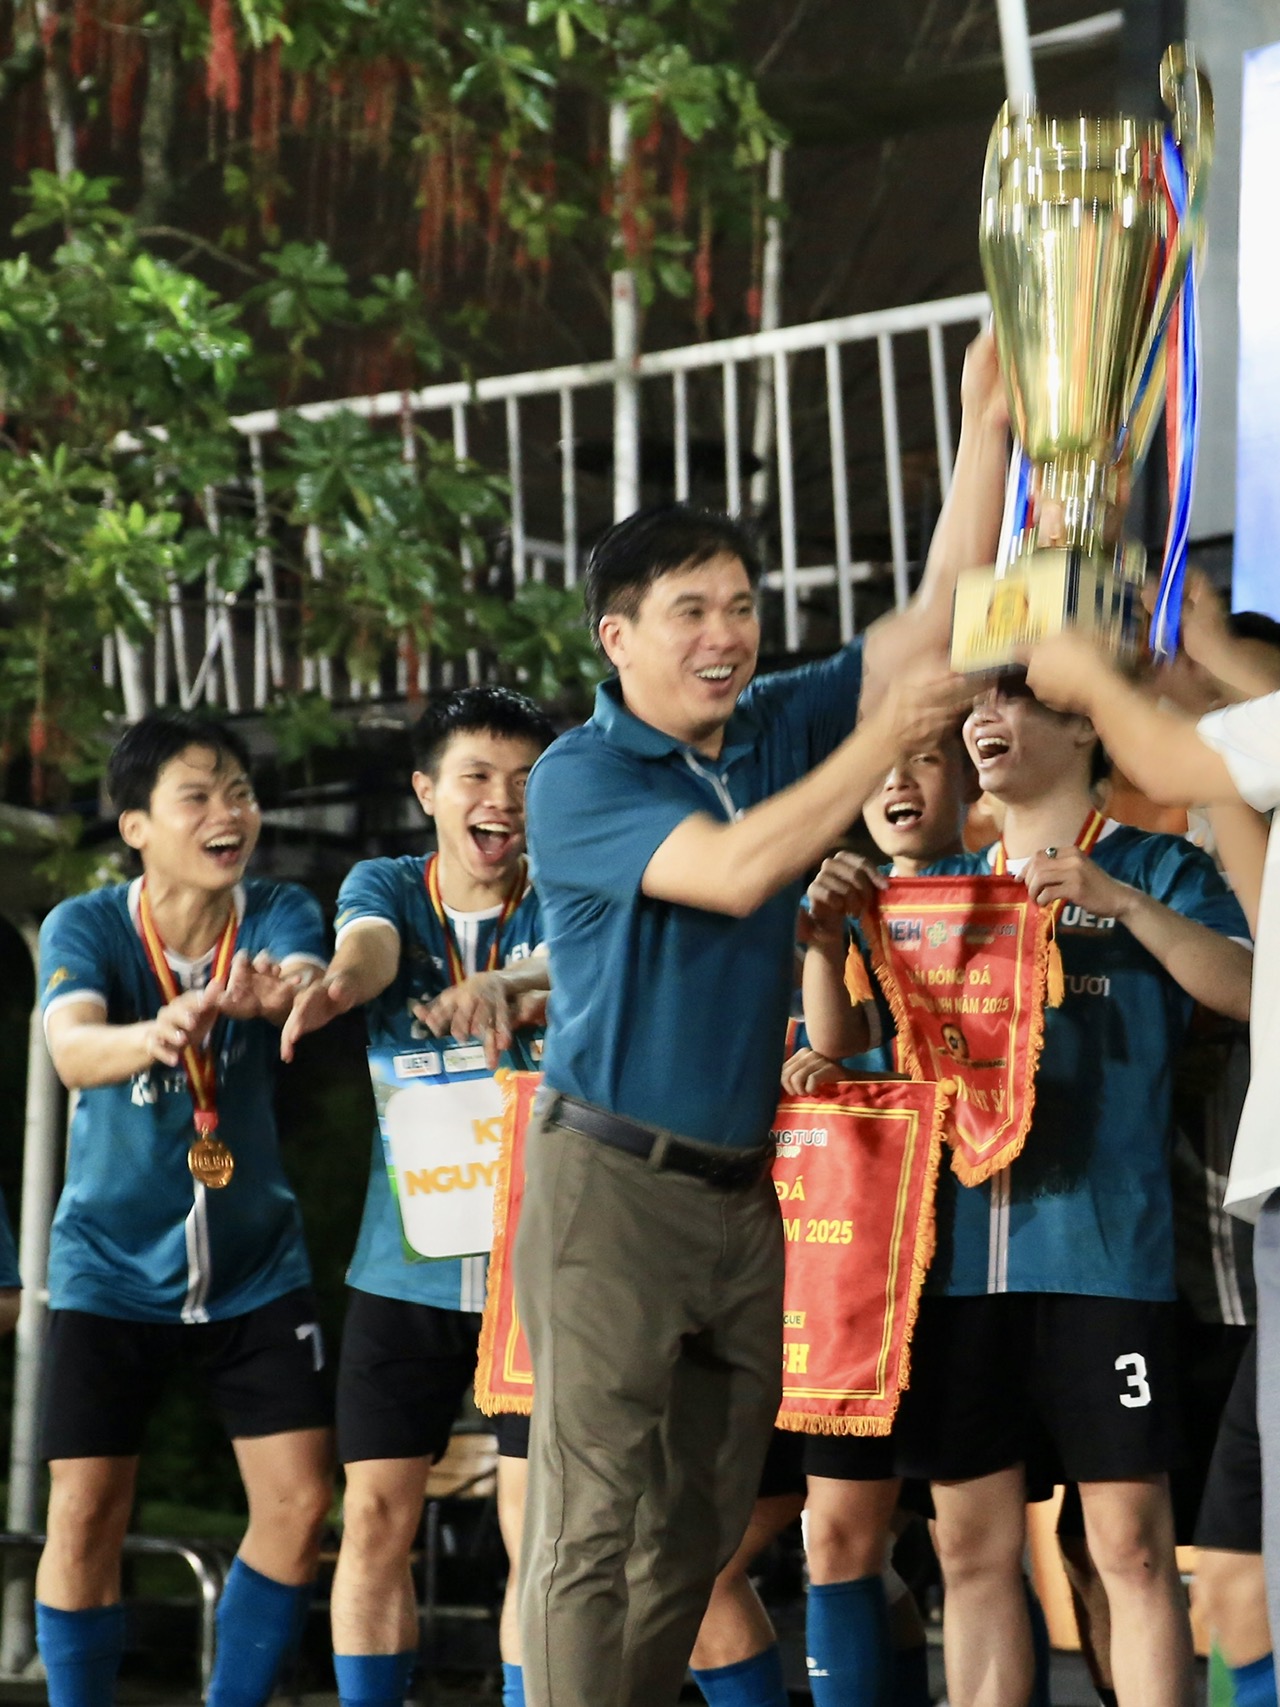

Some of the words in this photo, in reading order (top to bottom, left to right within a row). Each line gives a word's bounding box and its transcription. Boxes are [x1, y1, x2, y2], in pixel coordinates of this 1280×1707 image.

[969, 964, 992, 986] ĐÁ
[981, 996, 1010, 1015] 2025
[794, 1128, 828, 1147] TƯƠI
[805, 1220, 853, 1245] 2025
[1114, 1352, 1151, 1408] 3
